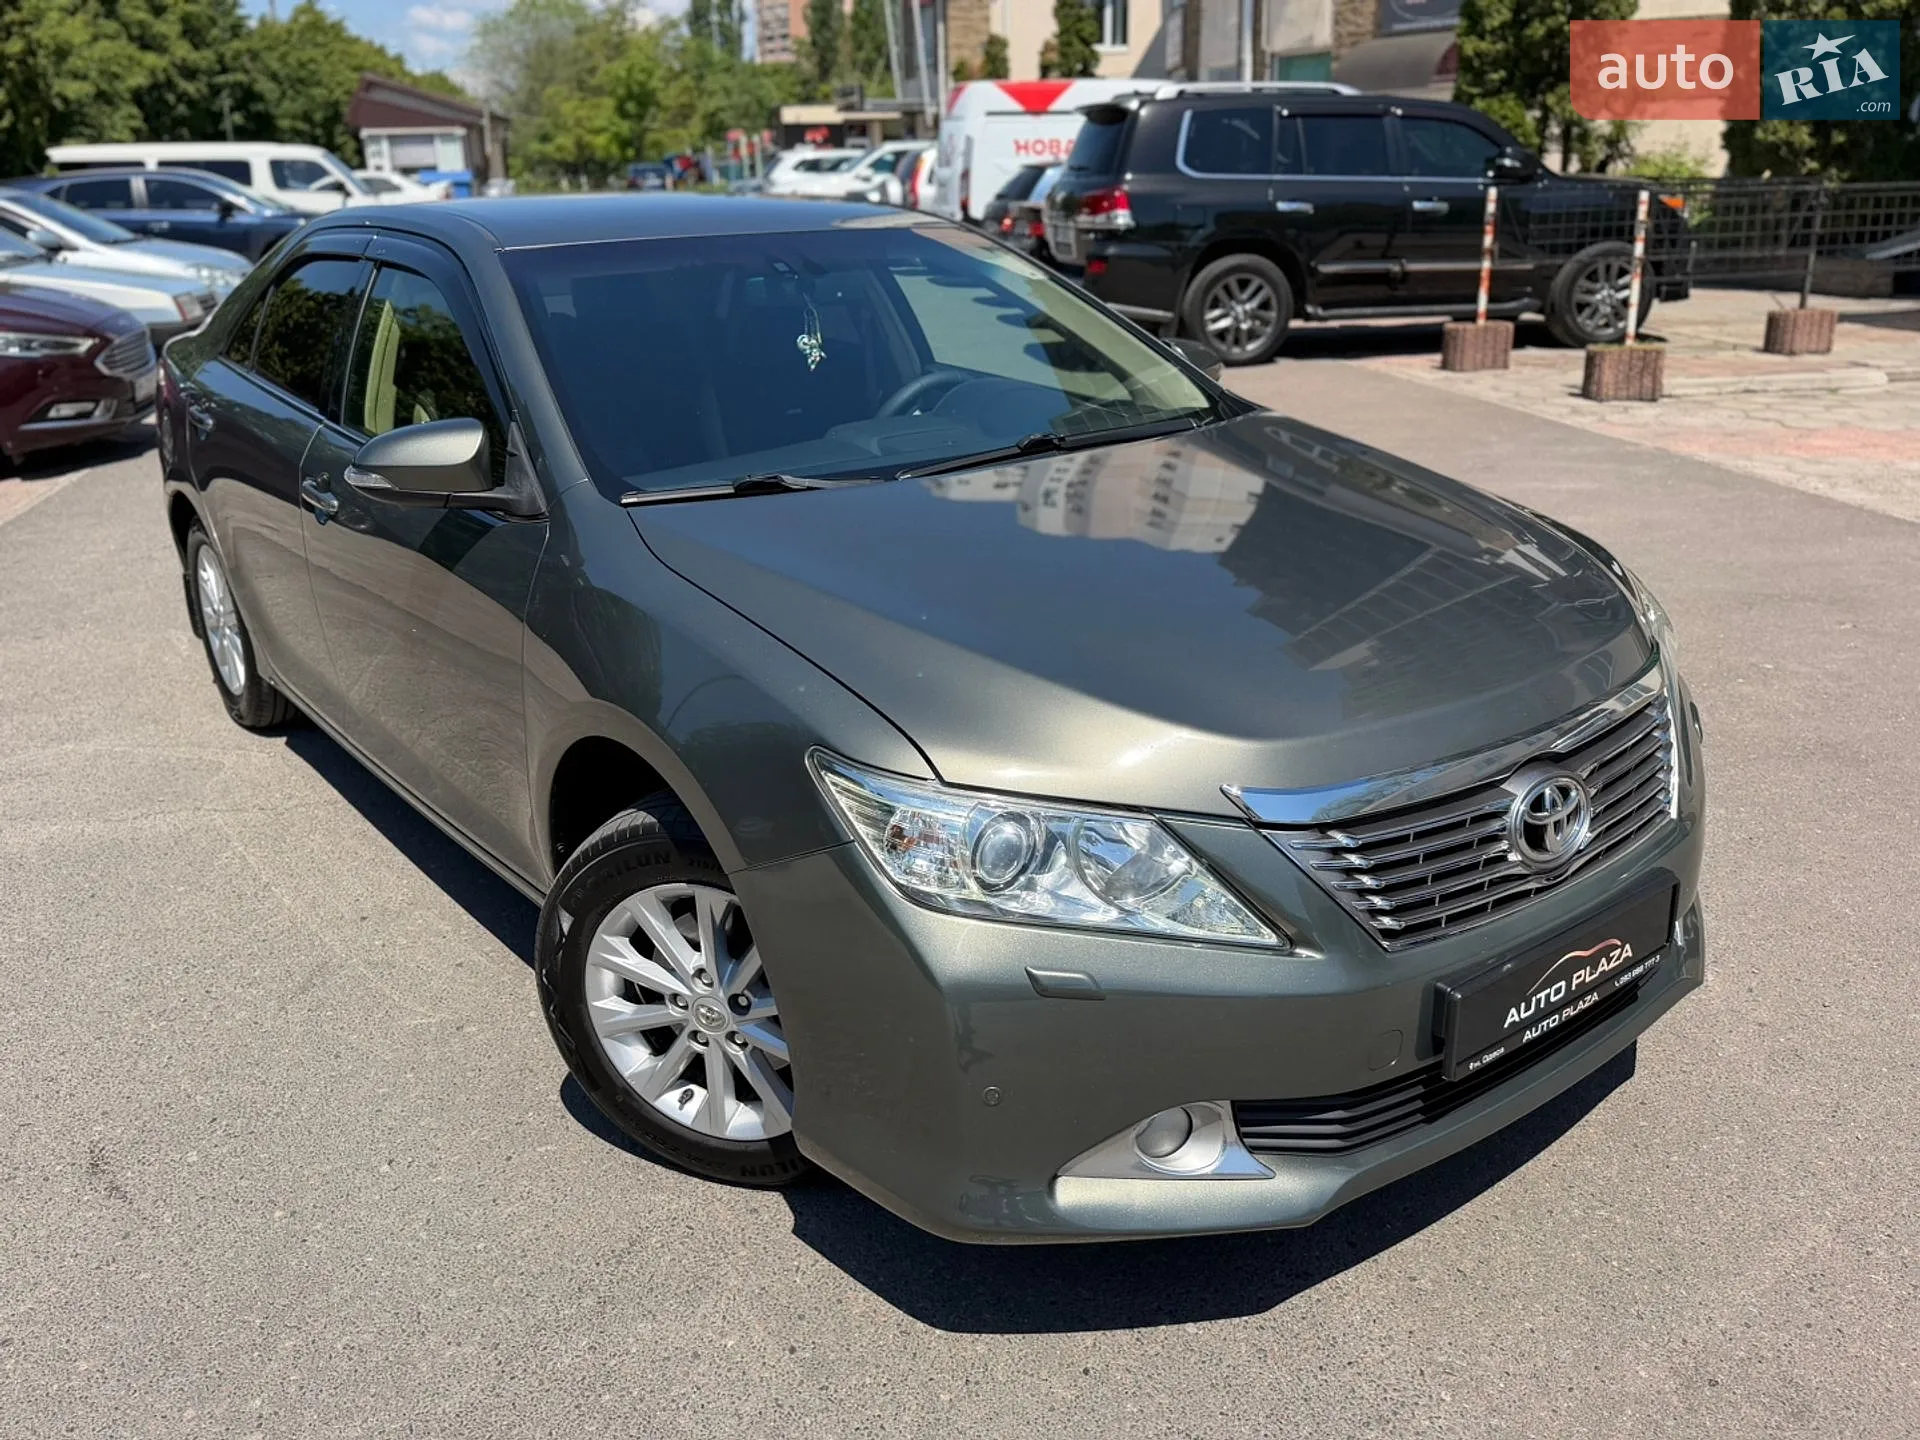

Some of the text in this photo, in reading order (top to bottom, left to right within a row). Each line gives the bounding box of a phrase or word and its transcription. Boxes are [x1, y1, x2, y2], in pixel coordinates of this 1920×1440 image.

[1503, 942, 1634, 1029] AUTO PLAZA
[1522, 991, 1600, 1044] AUTO PLAZA
